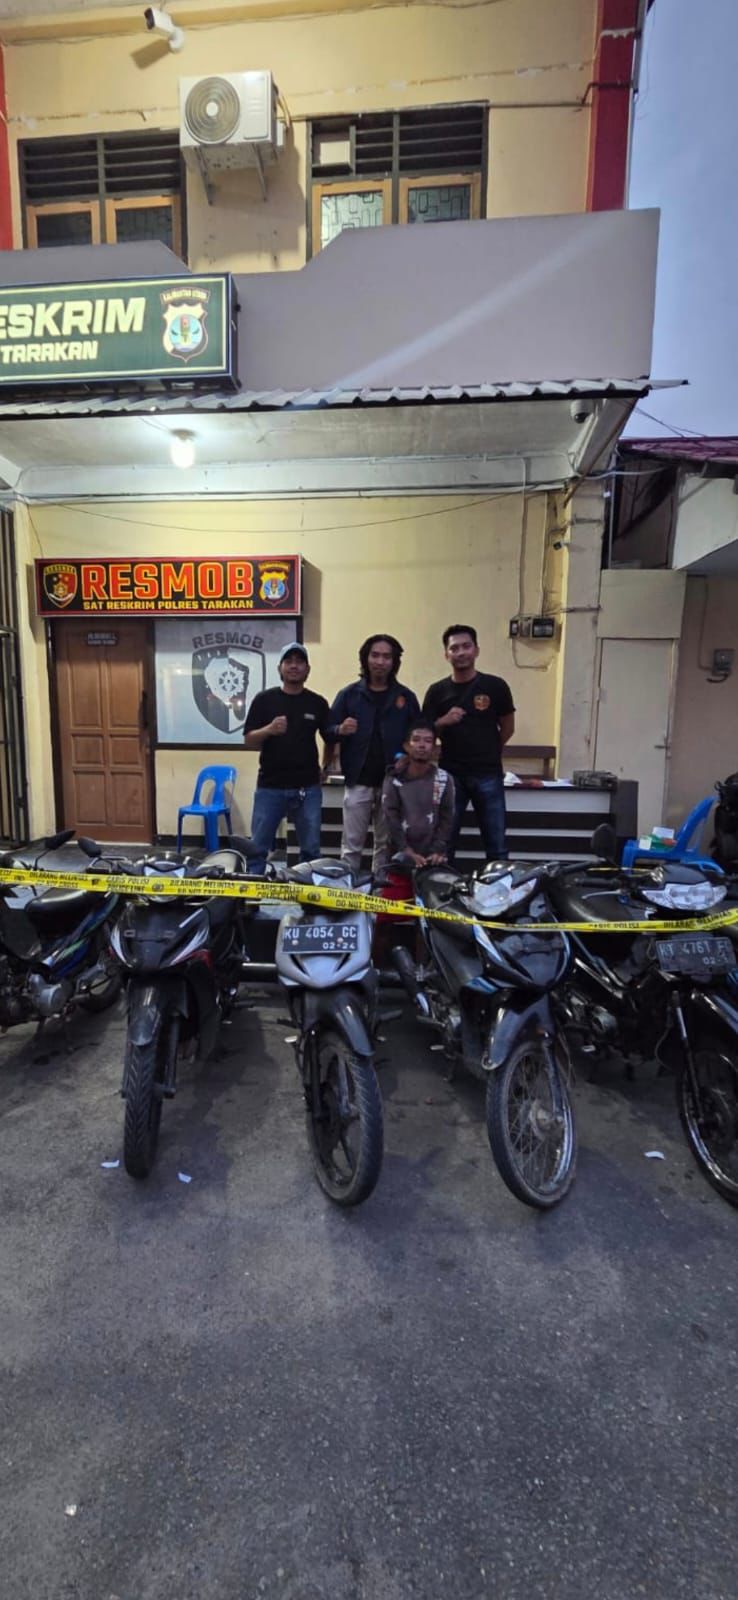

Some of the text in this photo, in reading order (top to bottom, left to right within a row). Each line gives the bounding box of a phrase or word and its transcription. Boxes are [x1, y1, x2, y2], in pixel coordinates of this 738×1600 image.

[1, 341, 98, 364] TARAKAN
[81, 562, 254, 600] RESMOB
[83, 600, 253, 610] SAT RESKRIM POLRES TARAKAN
[192, 631, 264, 649] RESMOB
[327, 889, 363, 899] DILARANG
[335, 899, 346, 907] DO
[348, 900, 362, 909] NOT
[284, 926, 357, 939] KU 4054 GC
[681, 940, 711, 954] 4761
